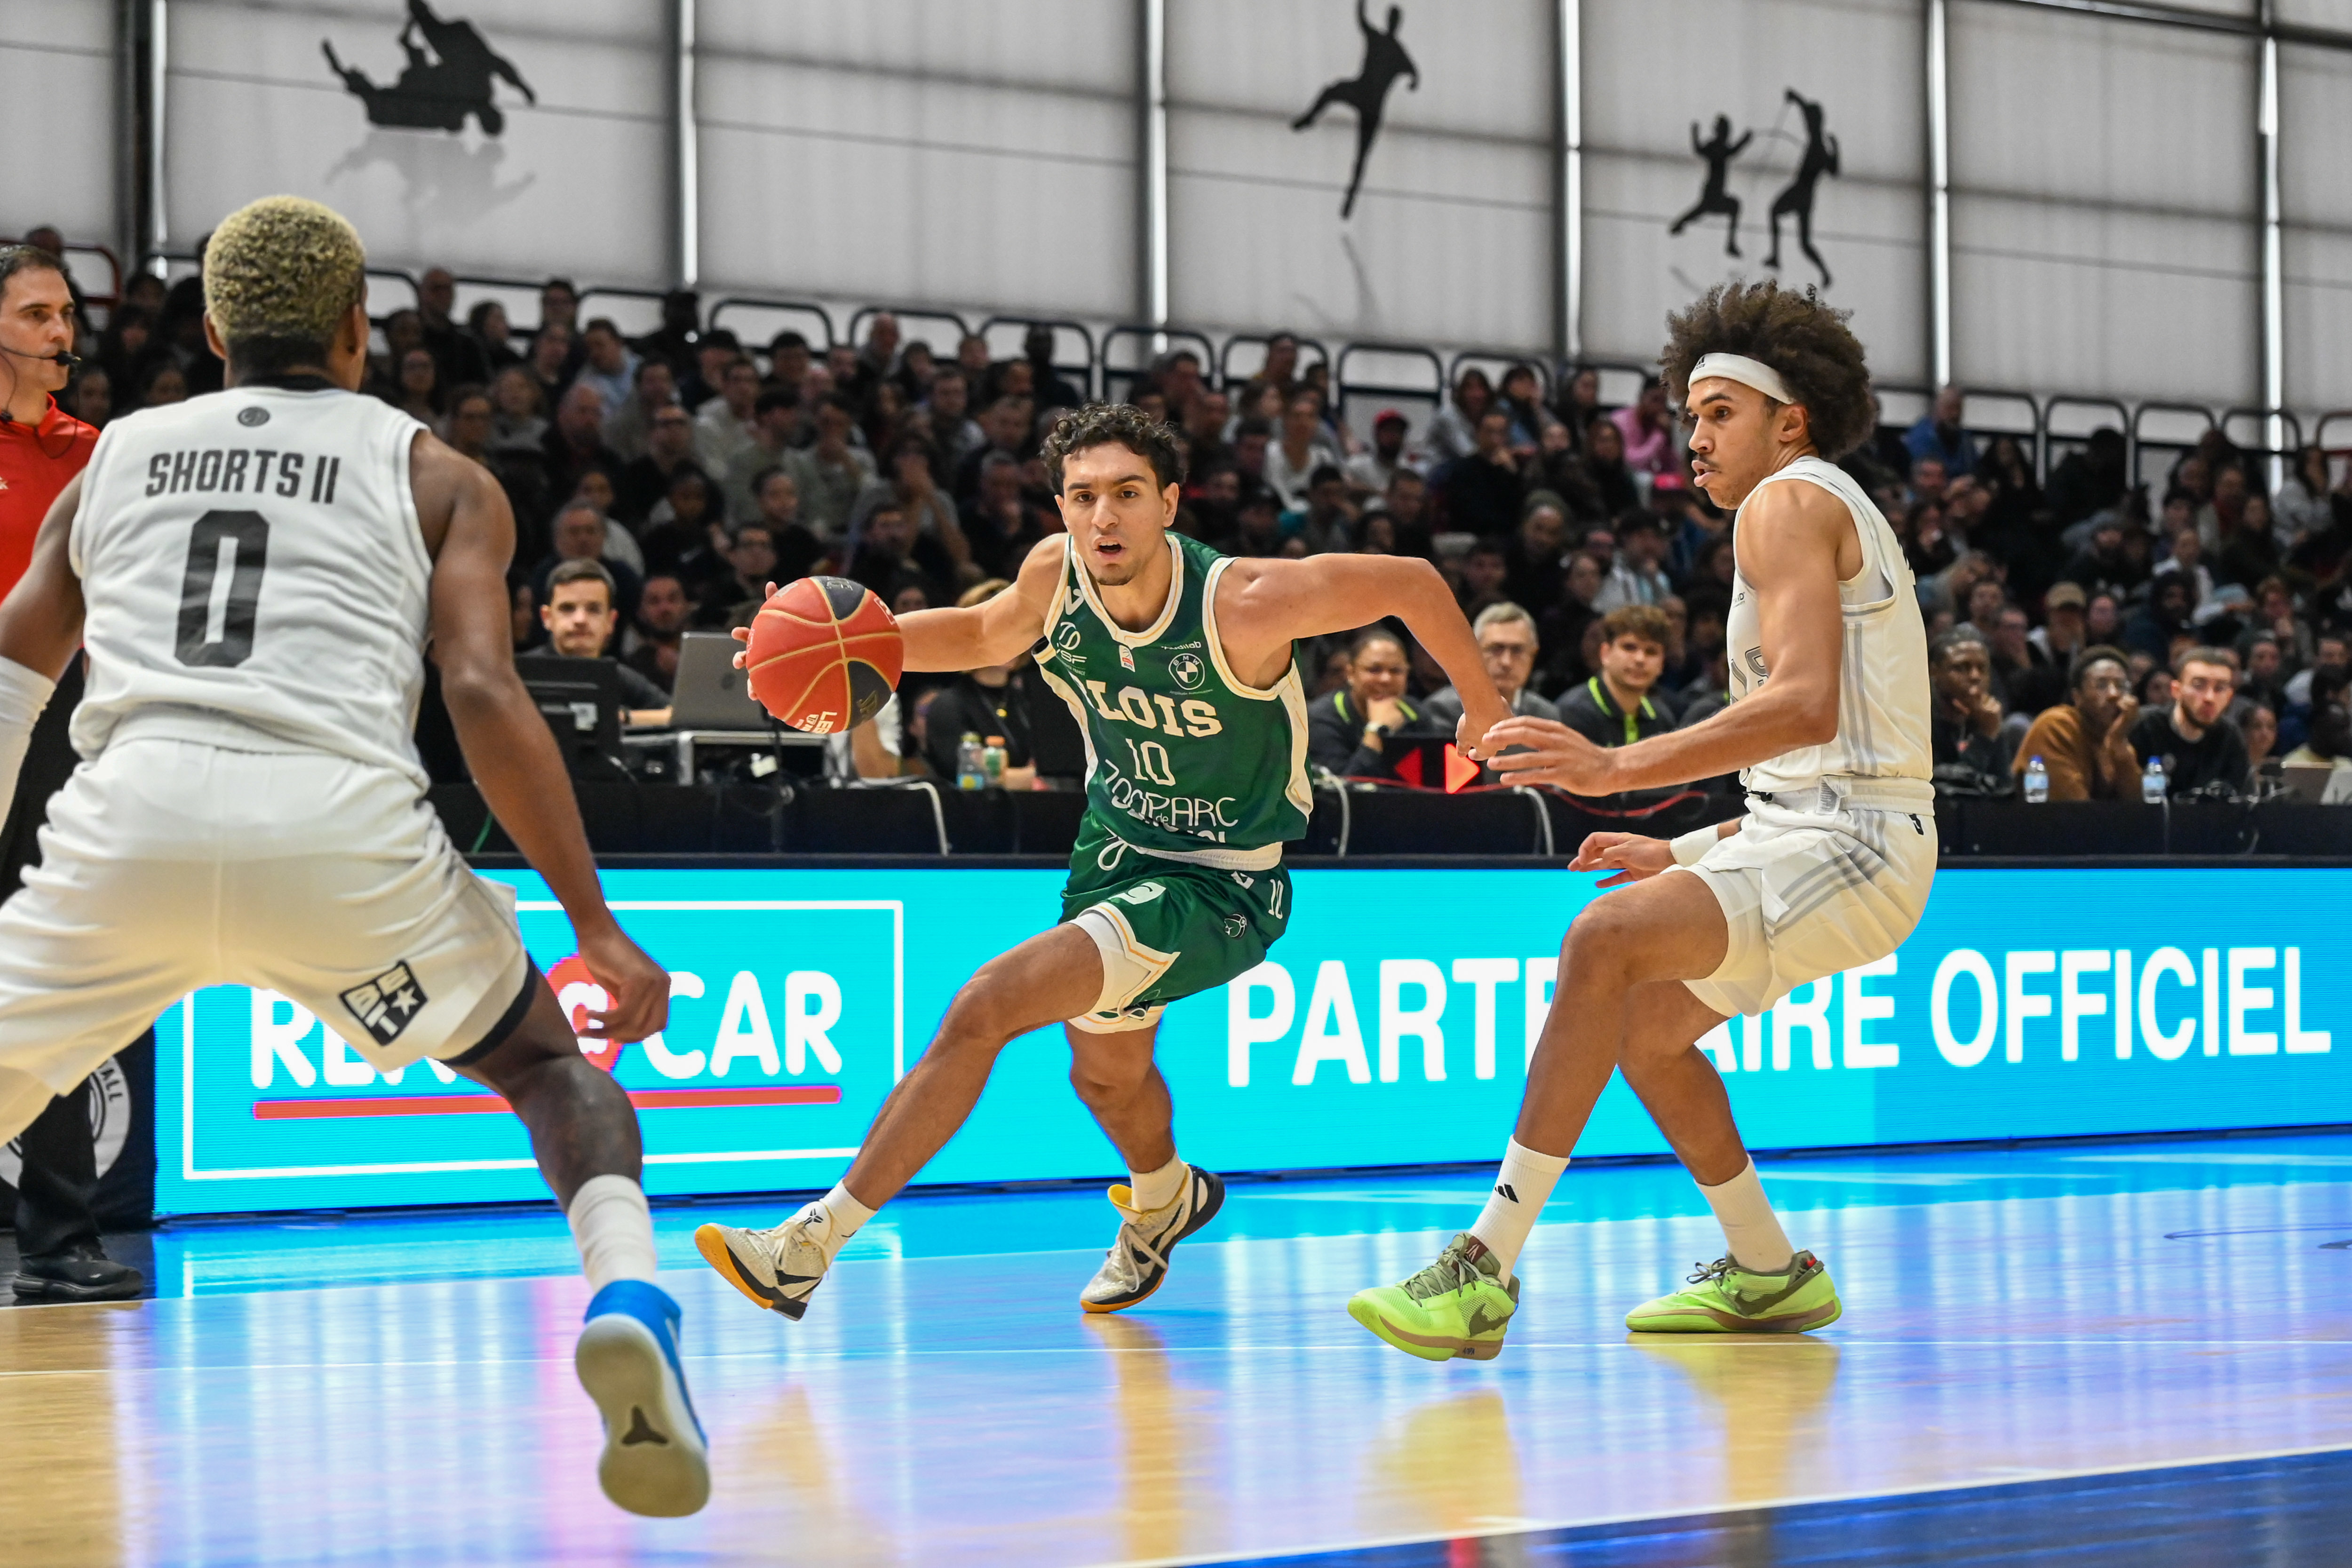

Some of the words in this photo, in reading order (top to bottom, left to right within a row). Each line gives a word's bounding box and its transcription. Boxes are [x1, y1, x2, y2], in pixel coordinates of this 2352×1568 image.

[145, 449, 303, 498] SHORTS
[174, 509, 270, 668] 0
[1068, 671, 1223, 737] LOIS
[1125, 738, 1176, 787] 10
[642, 970, 843, 1079] CAR
[1930, 946, 2332, 1067] OFFICIEL
